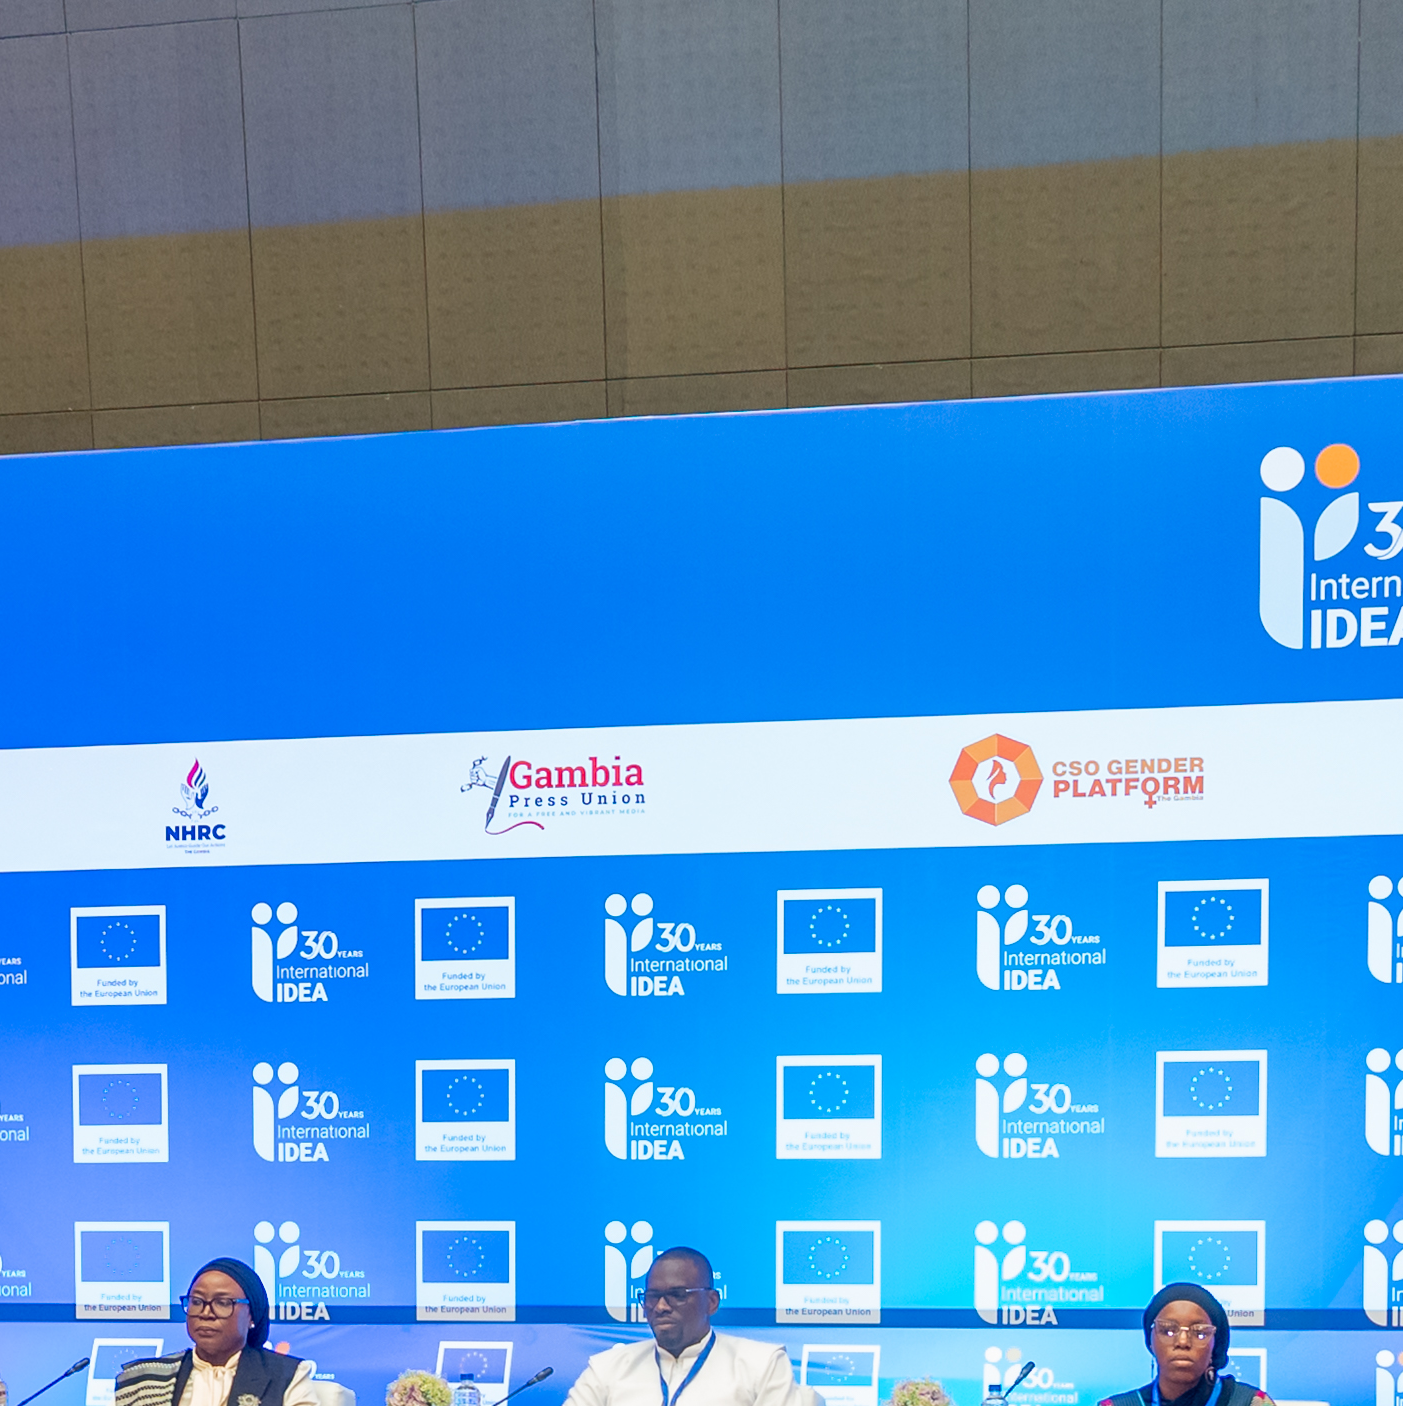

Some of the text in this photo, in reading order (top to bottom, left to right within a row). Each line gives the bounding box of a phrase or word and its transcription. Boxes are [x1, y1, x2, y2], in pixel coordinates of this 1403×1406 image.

[509, 755, 644, 790] Gambia
[1052, 757, 1204, 776] CSO GENDER
[1053, 775, 1204, 798] PLATFORM
[509, 791, 645, 808] Press Union
[165, 824, 226, 841] NHRC
